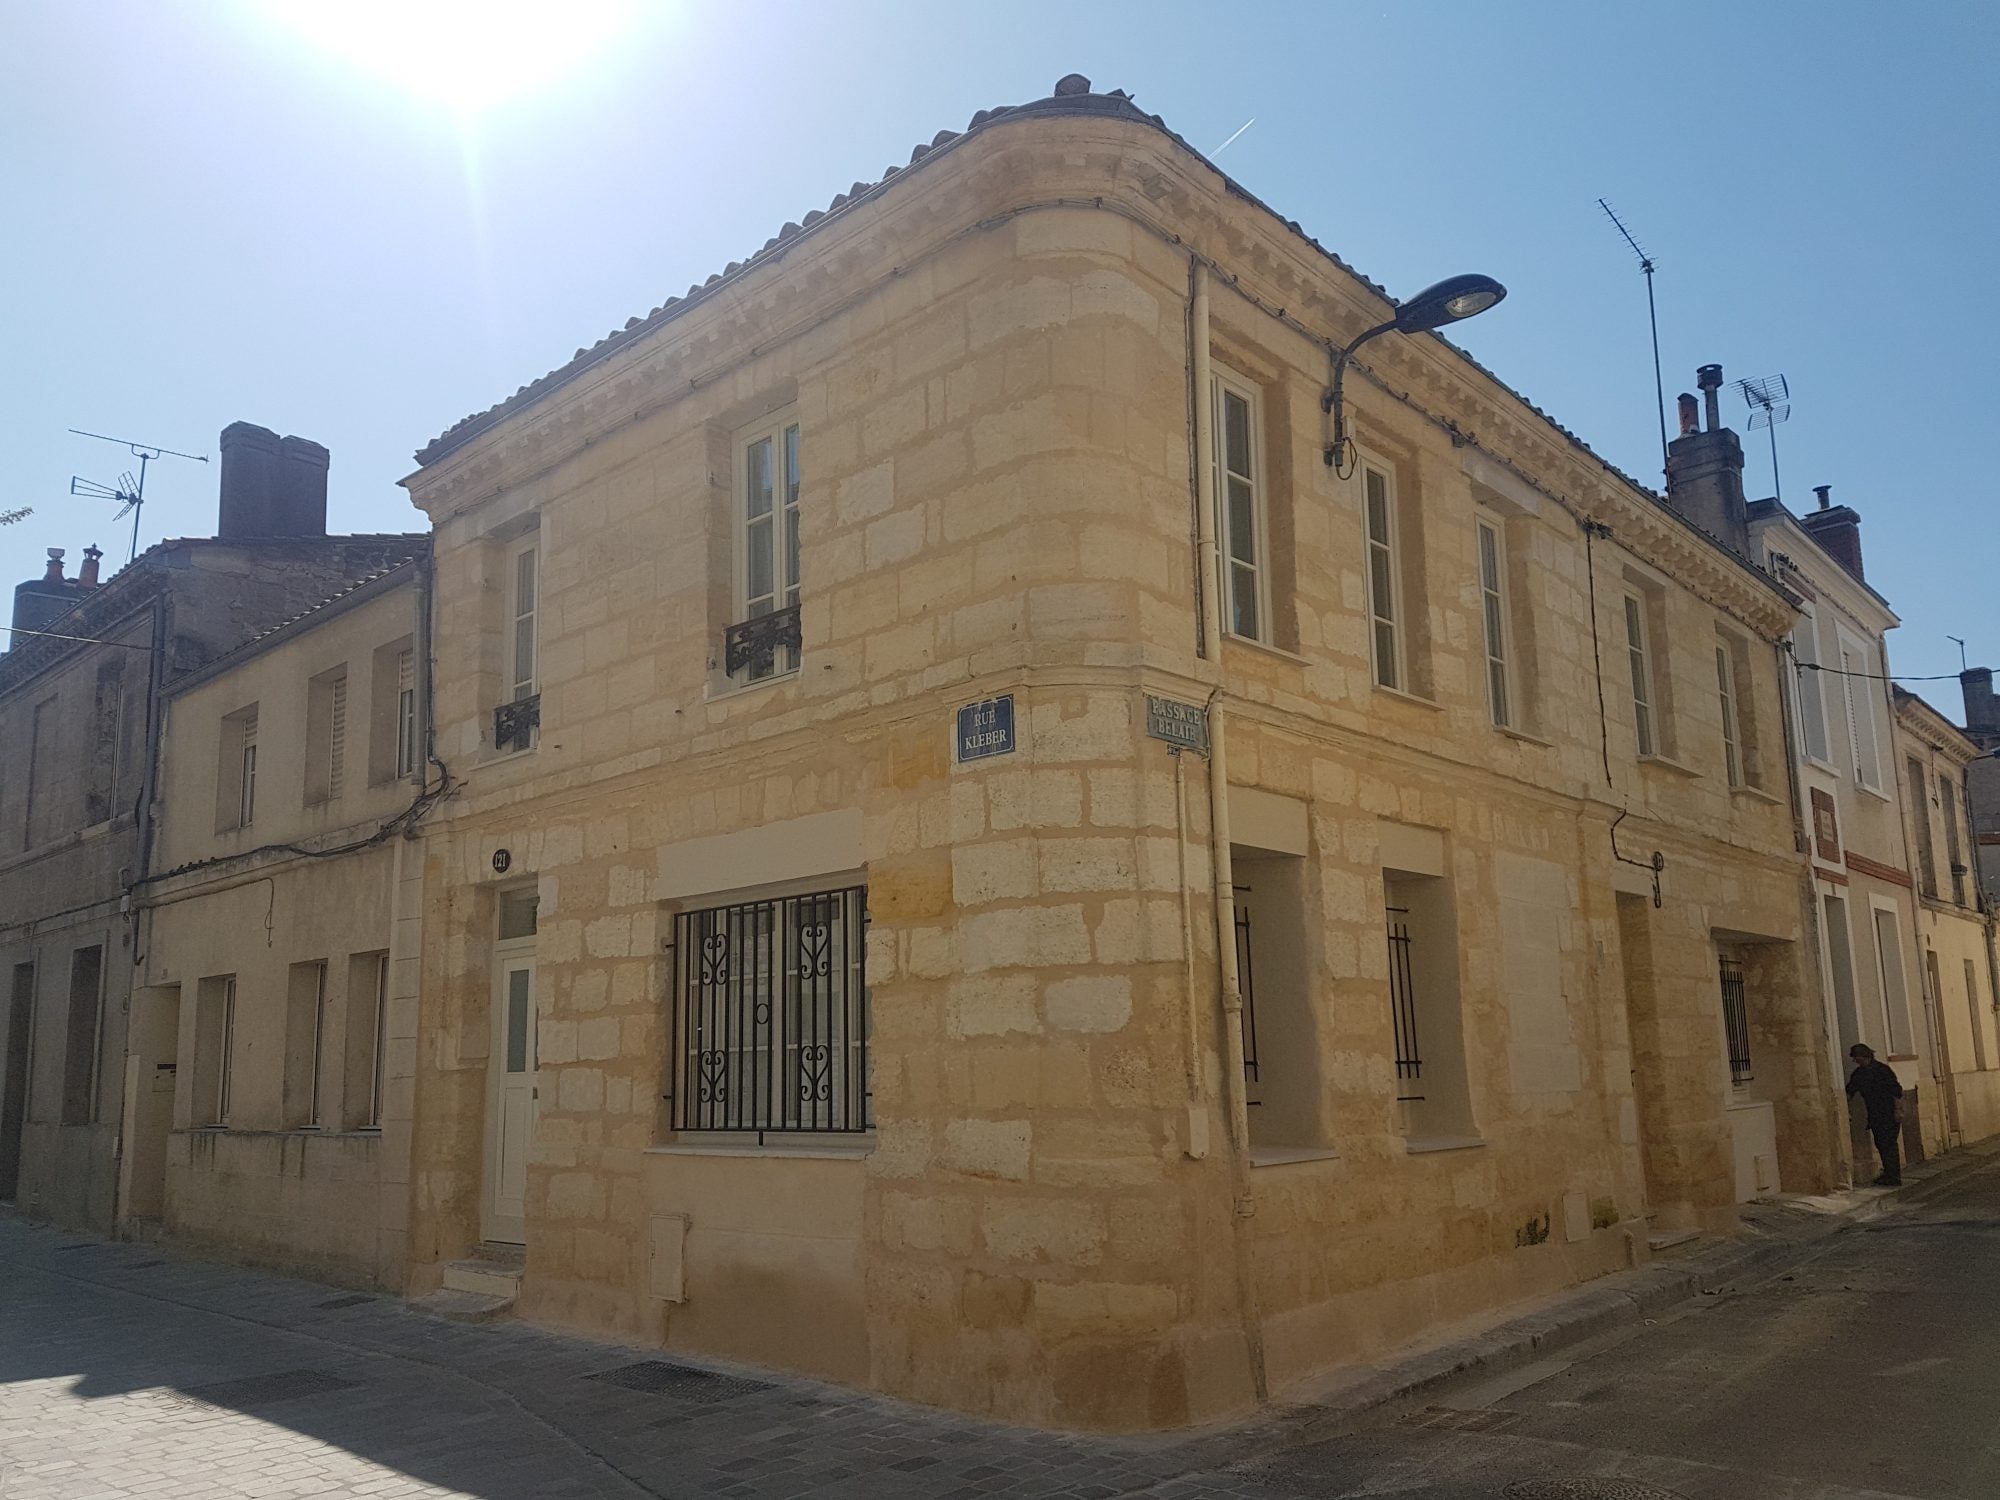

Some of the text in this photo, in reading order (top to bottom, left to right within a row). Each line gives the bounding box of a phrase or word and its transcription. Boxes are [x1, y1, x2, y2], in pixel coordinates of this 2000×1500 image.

[975, 710, 996, 726] RUE
[1152, 698, 1201, 725] PASSAGE
[965, 729, 1007, 750] KLEBER
[495, 853, 506, 867] 121
